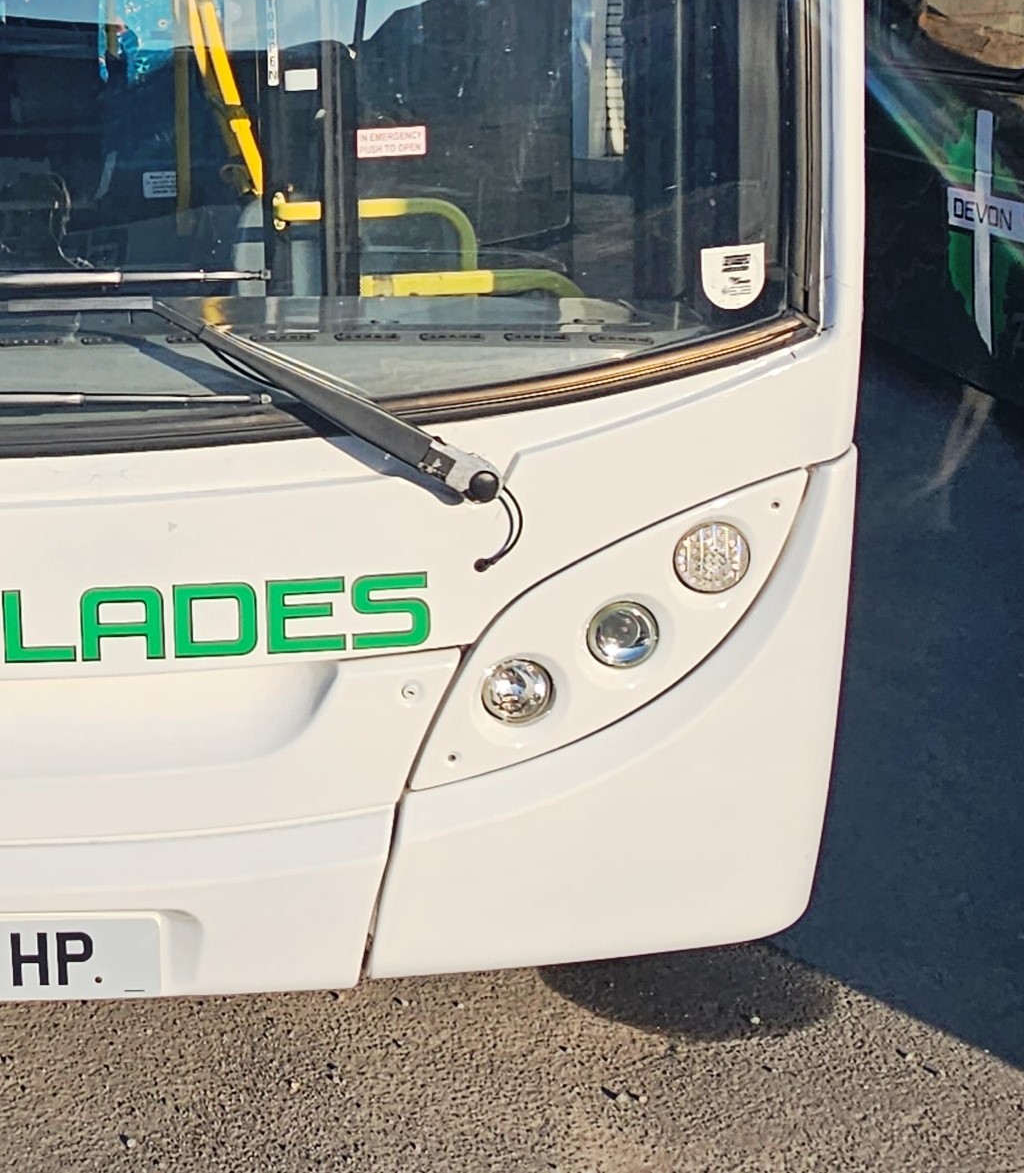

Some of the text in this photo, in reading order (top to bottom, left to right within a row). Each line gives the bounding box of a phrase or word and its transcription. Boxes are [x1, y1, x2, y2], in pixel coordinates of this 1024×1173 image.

[370, 131, 421, 141] EMERGENCY
[953, 197, 1013, 231] DEVON
[9, 931, 94, 988] HP
